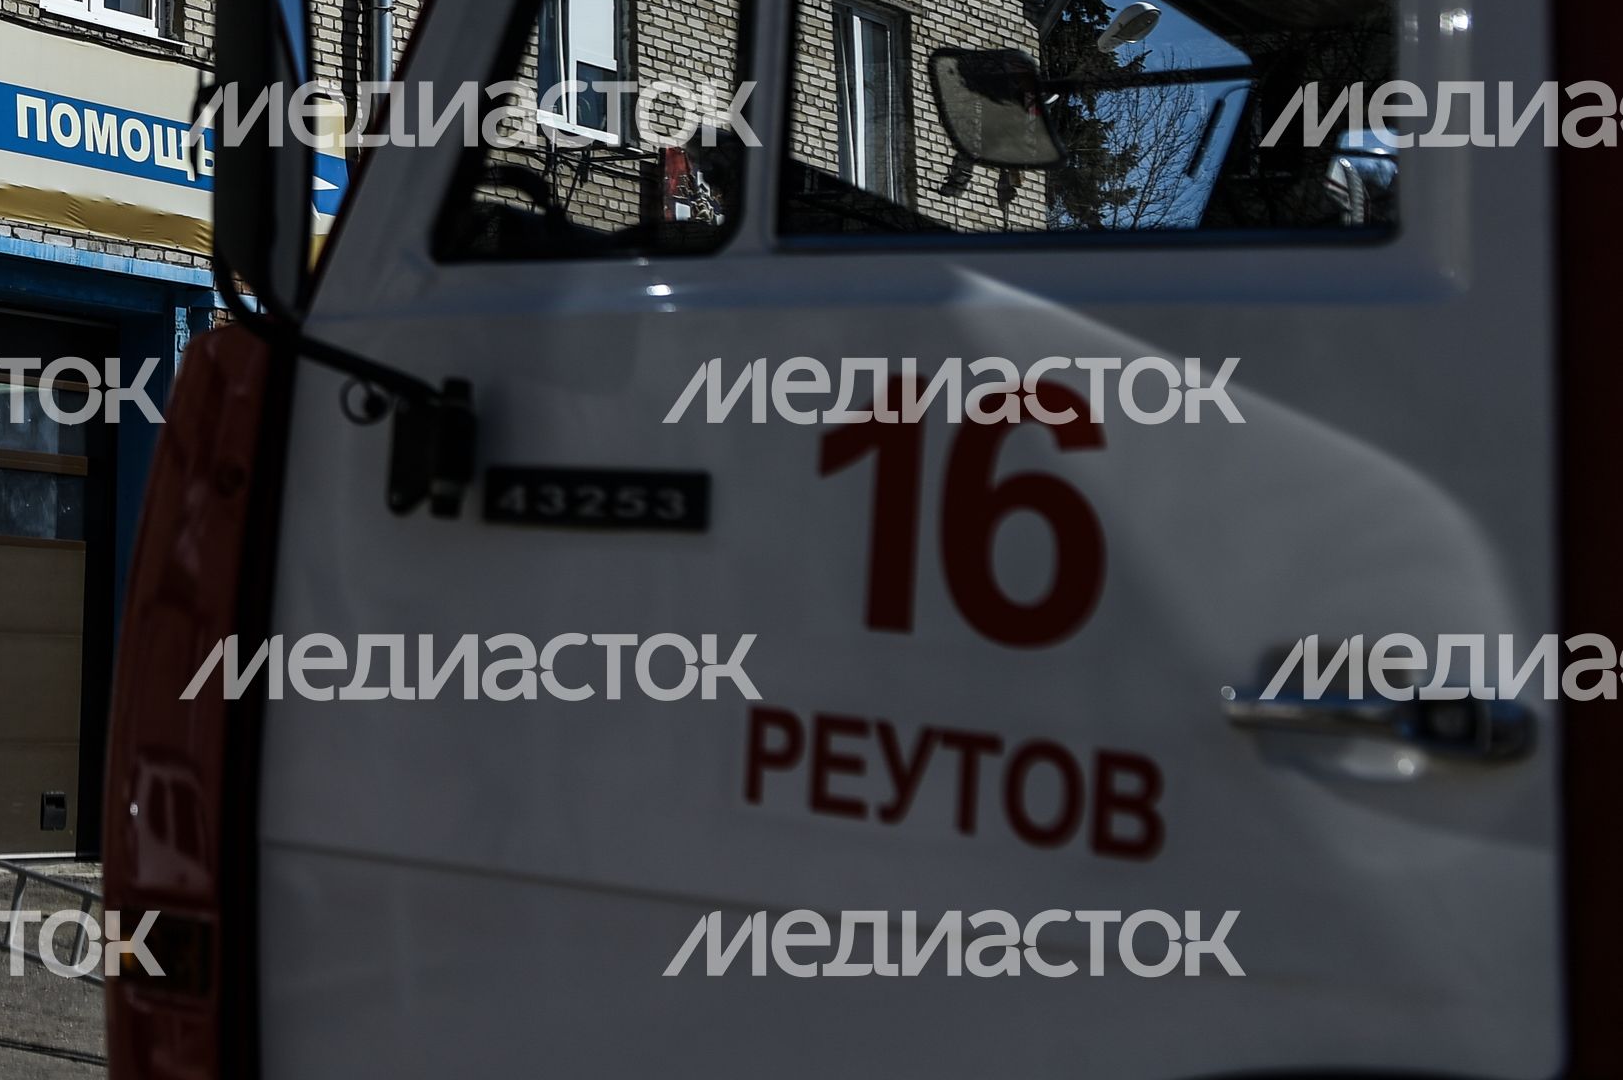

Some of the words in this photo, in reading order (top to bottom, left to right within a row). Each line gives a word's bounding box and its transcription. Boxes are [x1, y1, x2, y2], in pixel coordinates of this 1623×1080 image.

[16, 93, 216, 182] ПОМОЩЬ
[497, 483, 687, 520] 43253
[817, 373, 1108, 651] 16
[744, 704, 1166, 863] РЕУТОВ
